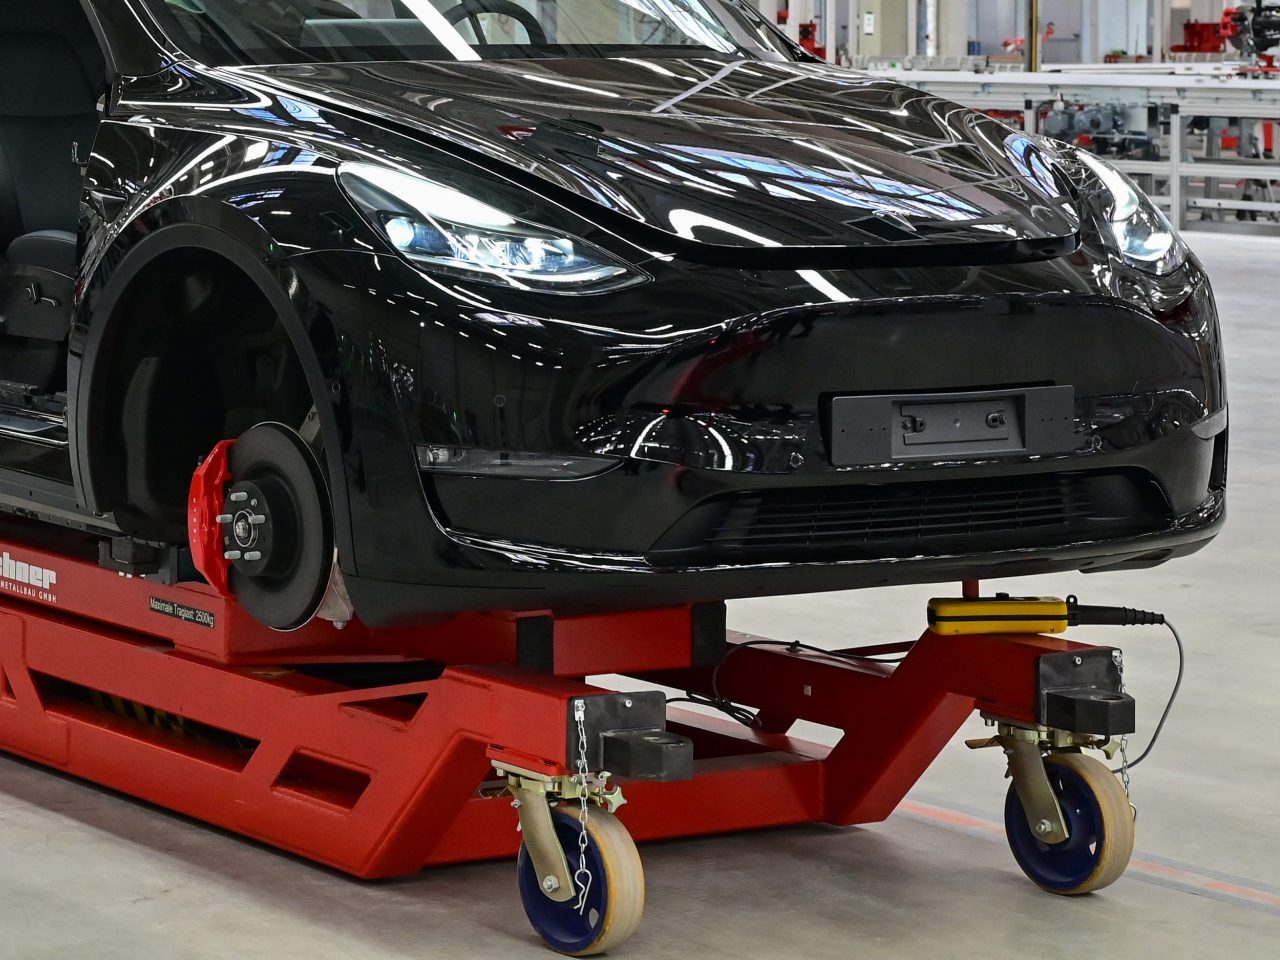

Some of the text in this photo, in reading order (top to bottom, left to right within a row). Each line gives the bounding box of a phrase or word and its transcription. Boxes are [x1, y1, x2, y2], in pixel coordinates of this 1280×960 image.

[0, 580, 36, 597] METALLBAU
[38, 591, 57, 603] GMBH
[150, 597, 173, 614] Maximale
[195, 610, 214, 628] 2500kg
